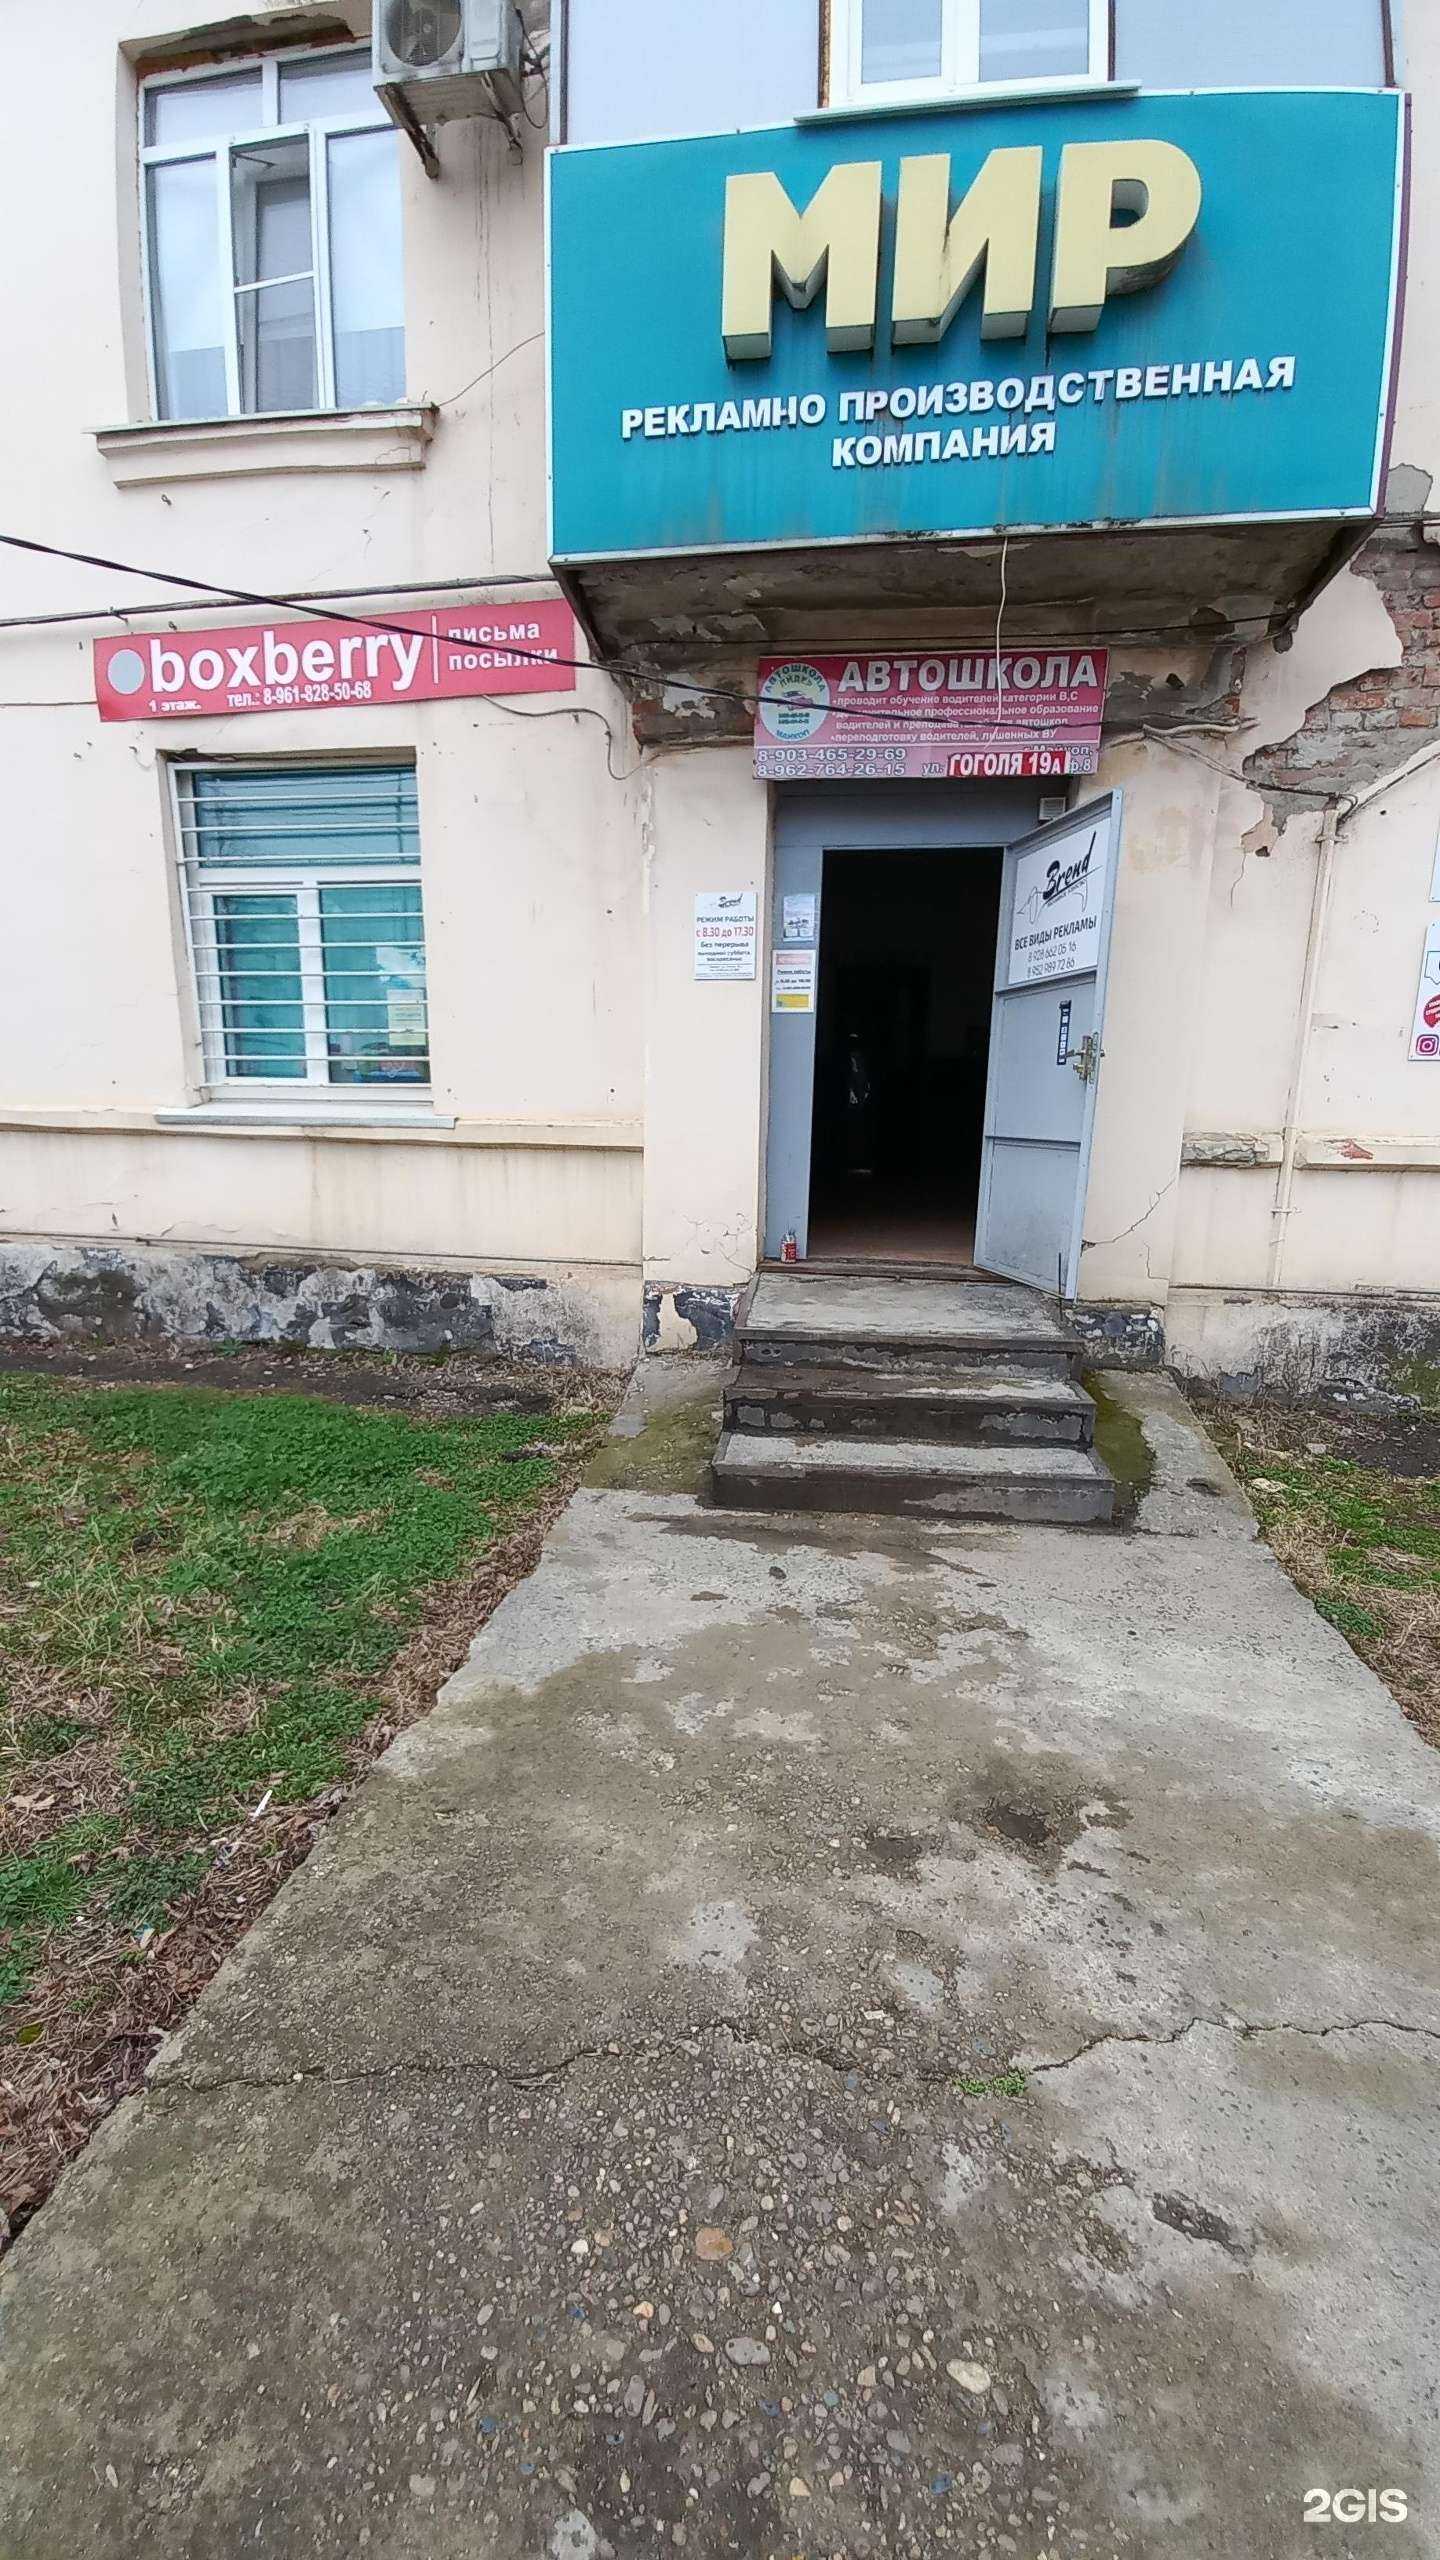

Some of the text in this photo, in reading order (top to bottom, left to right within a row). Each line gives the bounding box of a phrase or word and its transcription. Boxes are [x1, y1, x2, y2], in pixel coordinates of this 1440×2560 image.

[722, 139, 1203, 352] МИР
[620, 355, 1297, 440] РЕКЛАМНО ПРОИЗВОДСТВЕННАЯ
[831, 421, 1057, 469] КОМПАНИЯ
[448, 622, 540, 643] письма
[150, 630, 425, 691] boxberry
[448, 647, 559, 671] посылки
[837, 655, 1099, 693] АВТОШКОЛА
[262, 680, 373, 706] 8-961-828-50-68
[837, 696, 887, 707] проводит
[889, 694, 940, 706] обучение
[942, 692, 1000, 704] водителей
[1002, 692, 1057, 704] категории
[149, 700, 157, 712] 1
[924, 705, 1027, 718] профессиональное
[1029, 704, 1099, 715] образование
[836, 720, 891, 730] водителей
[893, 720, 901, 729] и
[836, 731, 918, 743] переподготовку
[919, 731, 979, 742] водителей,
[1041, 728, 1057, 739] ВУ
[757, 748, 907, 763] 8-903-465-29-69
[921, 763, 944, 777] ул.
[949, 753, 1024, 777] ГОГОЛЯ
[756, 763, 906, 777] 8-962-764-26-15
[1042, 829, 1097, 901] Brend
[702, 926, 720, 938] 8.30
[721, 928, 733, 939] до
[733, 925, 754, 937] 17.30
[1014, 915, 1097, 952] ВСЕ ВИДЫ РЕКЛАМЫ
